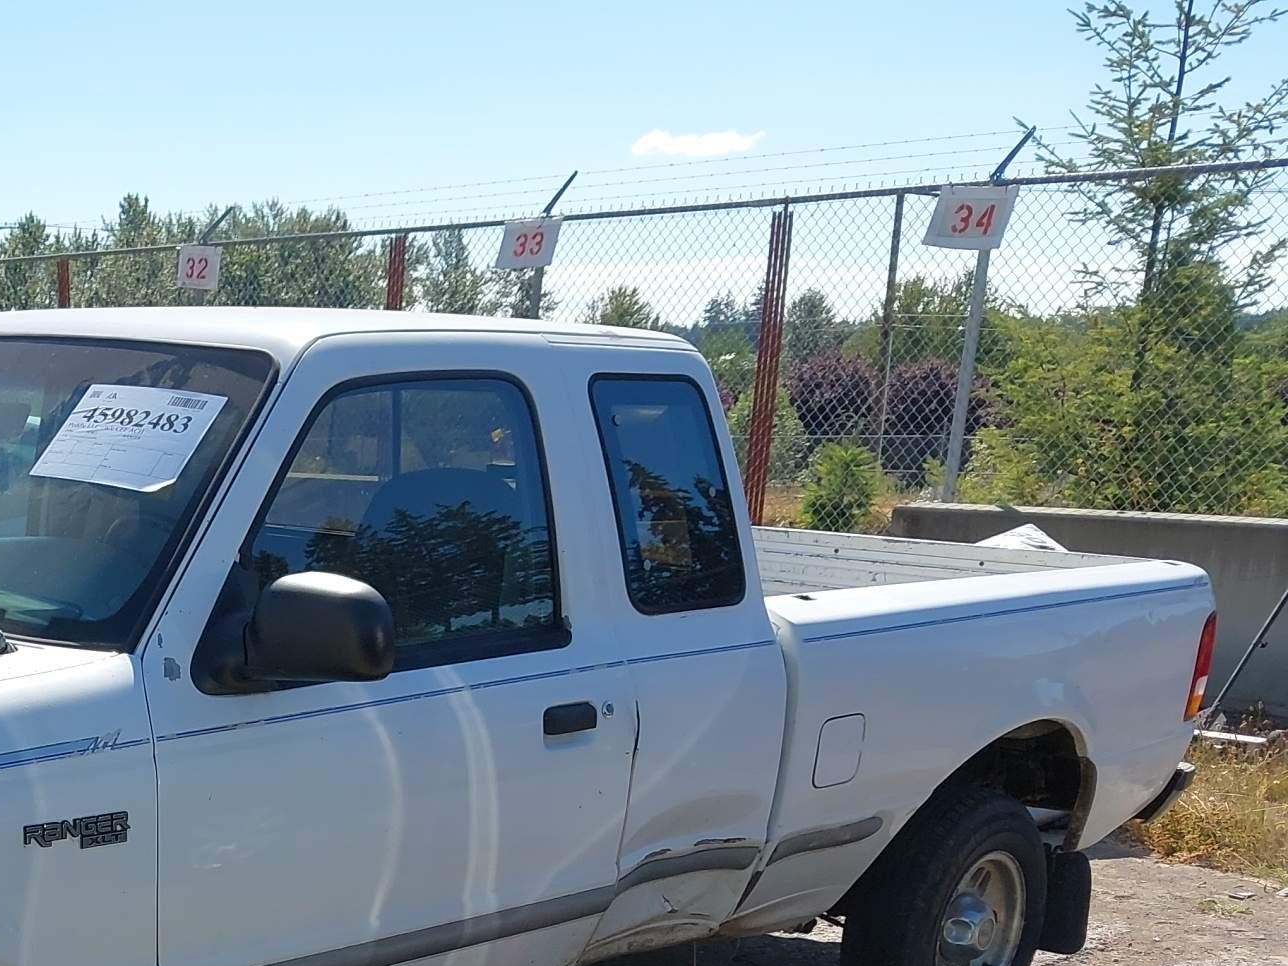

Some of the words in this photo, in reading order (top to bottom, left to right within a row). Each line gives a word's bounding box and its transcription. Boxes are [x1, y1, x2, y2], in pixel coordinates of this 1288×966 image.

[951, 203, 996, 235] 34
[513, 231, 544, 257] 33
[185, 256, 208, 279] 32
[82, 405, 193, 434] 45982483
[23, 811, 130, 848] RANGER
[86, 832, 125, 847] XLT
